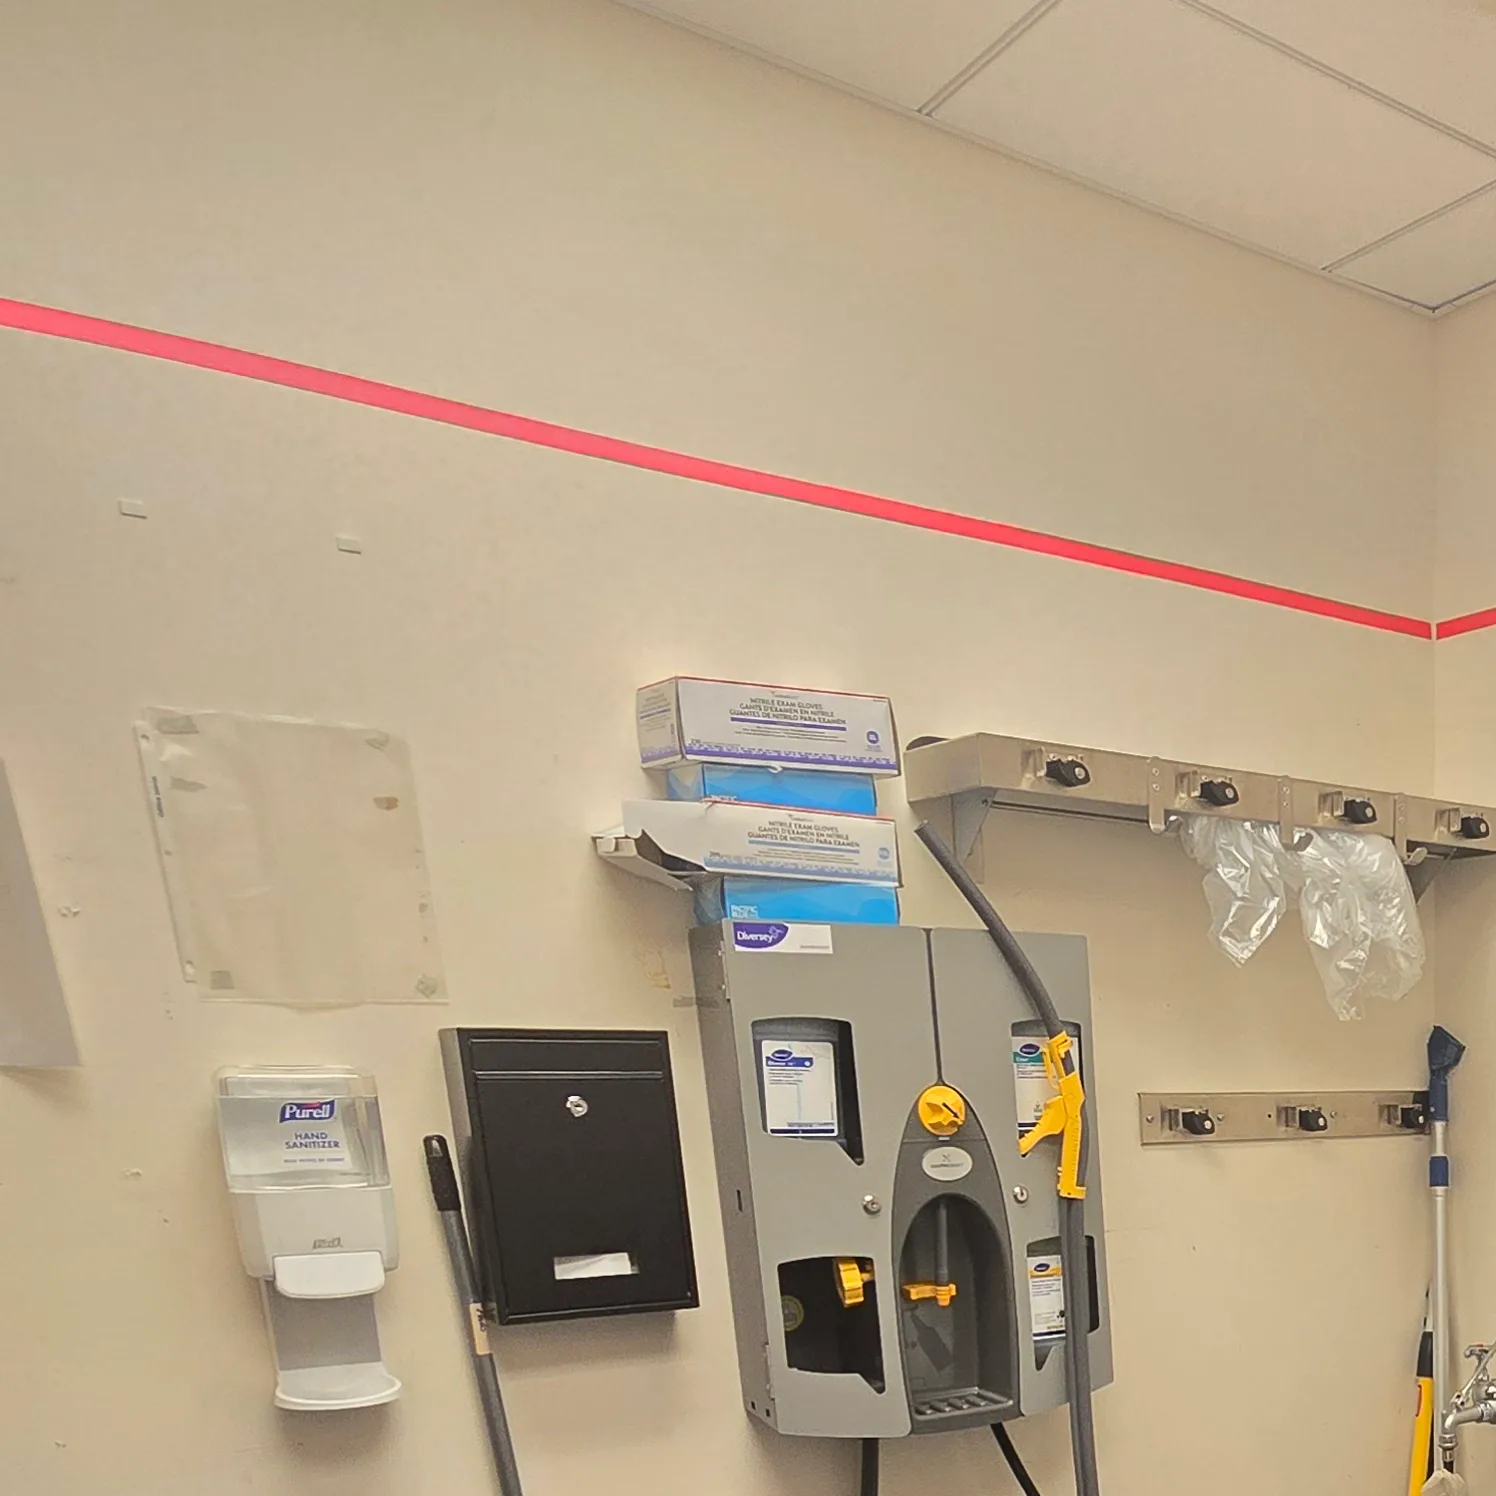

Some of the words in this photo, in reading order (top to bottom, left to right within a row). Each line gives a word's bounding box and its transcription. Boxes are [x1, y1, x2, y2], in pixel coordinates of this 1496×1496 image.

[740, 703, 762, 711] GANTS
[750, 697, 775, 706] NITRILE
[777, 699, 796, 708] EXAM
[797, 702, 823, 710] GLOVES
[729, 709, 760, 717] GUANTES
[768, 820, 792, 828] NITRILE
[794, 822, 812, 830] EXAM
[814, 824, 839, 832] GLOVES
[736, 931, 773, 943] Diversey
[285, 1104, 330, 1118] Purell
[294, 1132, 328, 1140] HAND
[285, 1140, 340, 1149] SANITIZER
